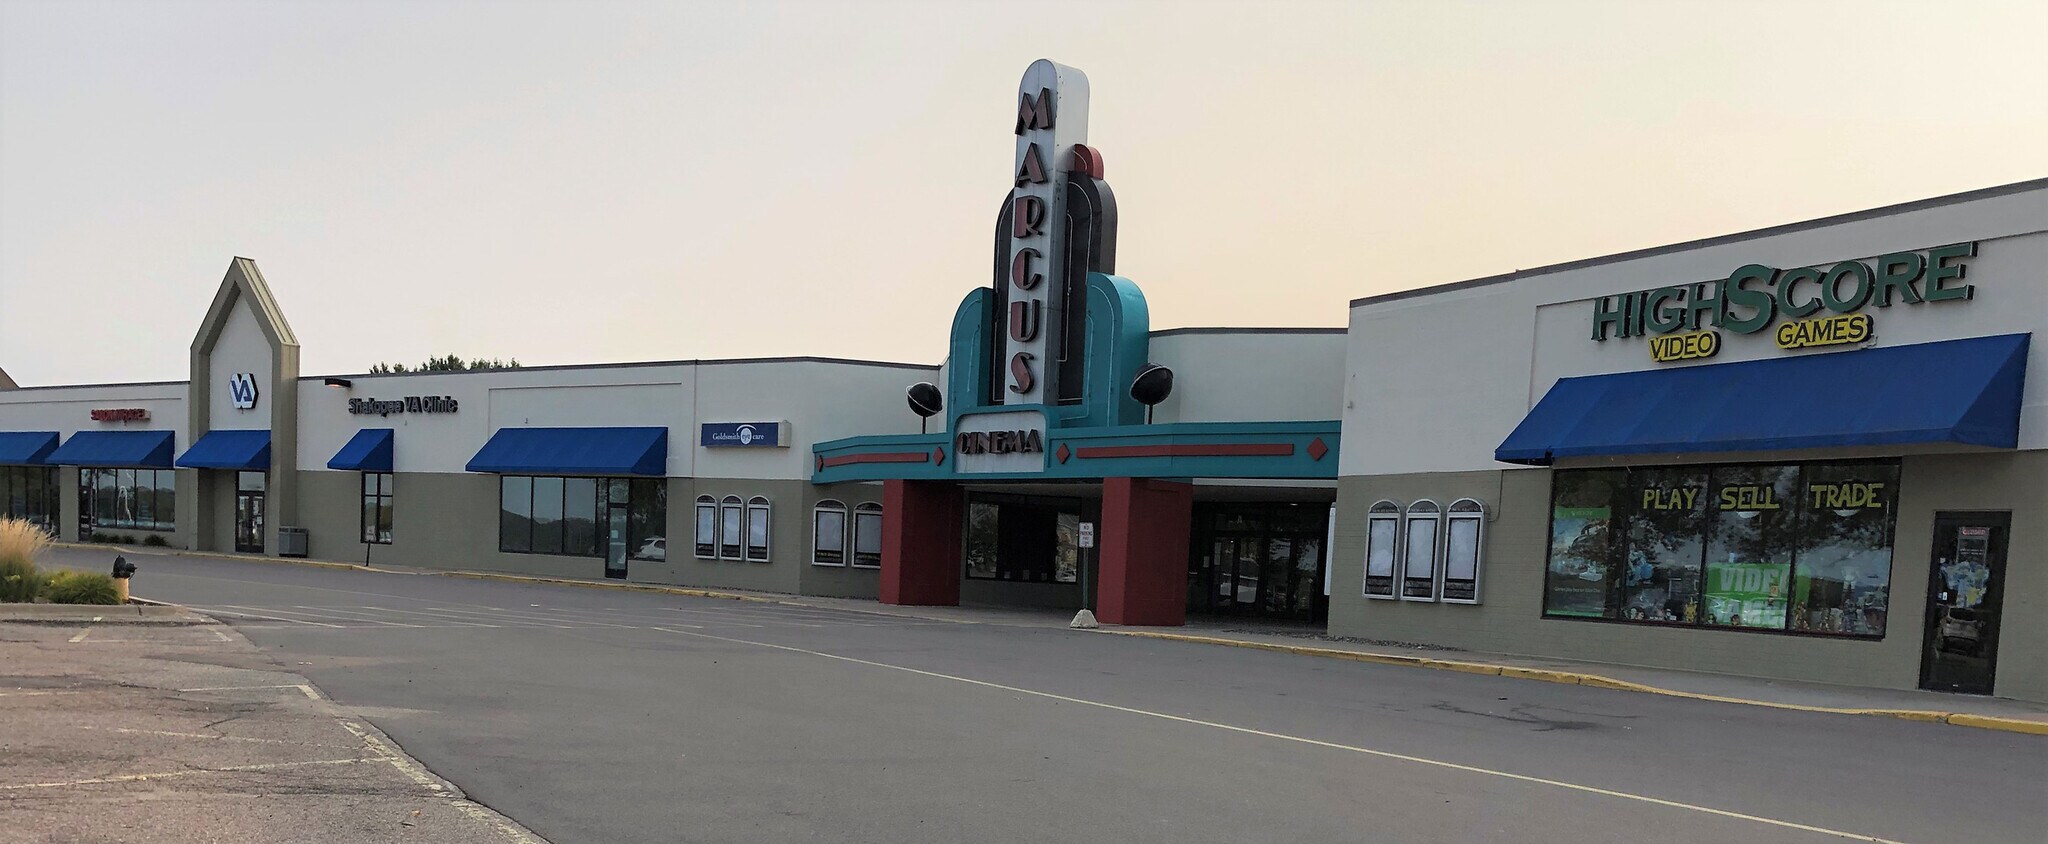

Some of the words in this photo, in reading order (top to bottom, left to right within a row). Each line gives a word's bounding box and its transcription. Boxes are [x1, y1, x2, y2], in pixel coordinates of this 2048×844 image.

[1010, 86, 1054, 395] MARCUS
[1650, 333, 1714, 360] VIDEO
[1778, 316, 1867, 346] GAMES
[230, 378, 253, 403] VA
[348, 397, 404, 417] Shakopee
[404, 396, 422, 413] VA
[422, 396, 459, 413] Clinic
[712, 432, 741, 440] Goldsmith
[956, 429, 1043, 454] CINEMA
[1643, 487, 1698, 510] PLAY
[1720, 486, 1780, 510] SELL
[1810, 482, 1885, 508] TRADE
